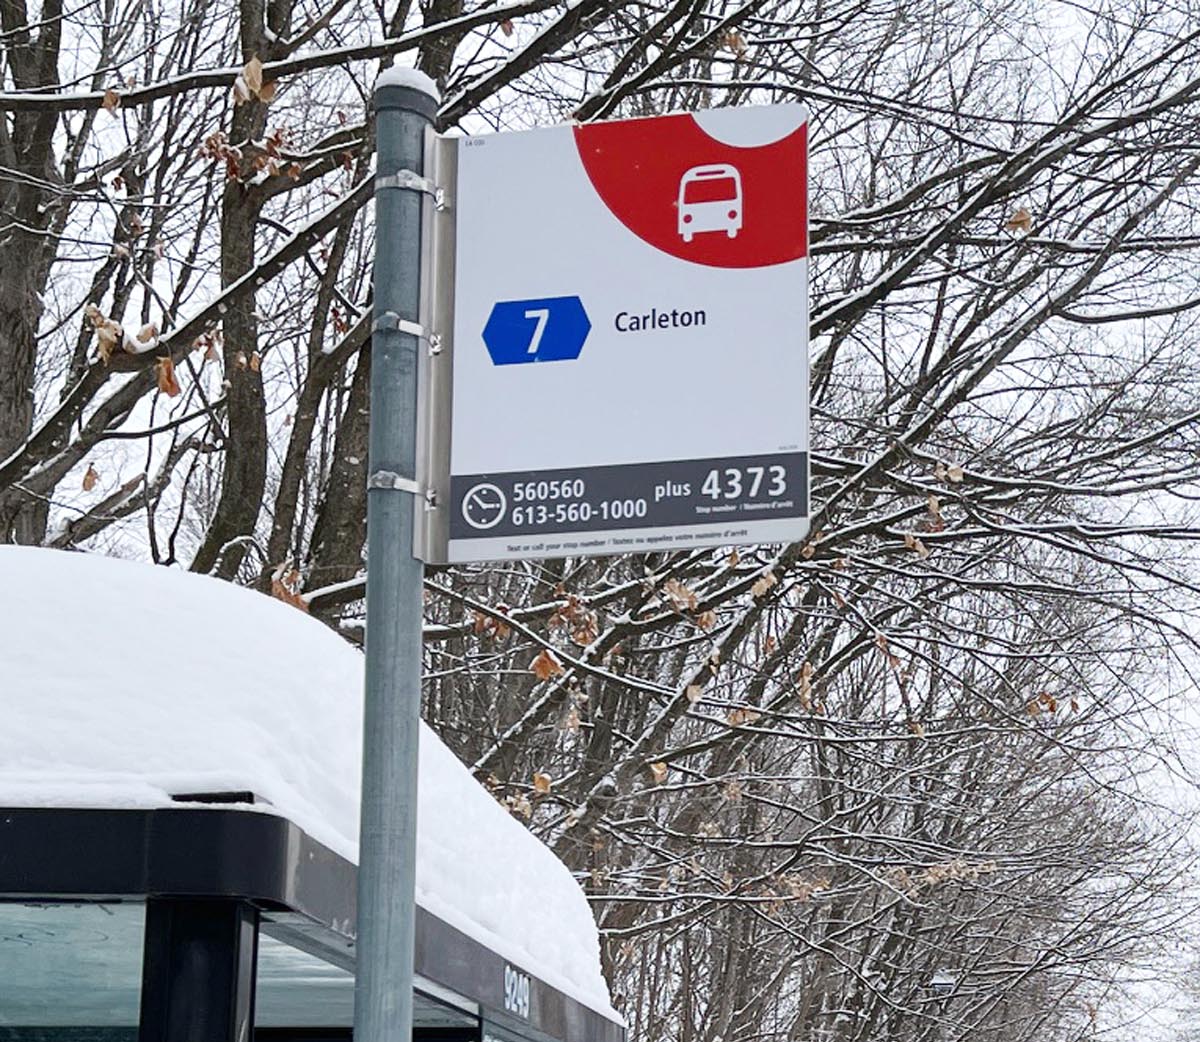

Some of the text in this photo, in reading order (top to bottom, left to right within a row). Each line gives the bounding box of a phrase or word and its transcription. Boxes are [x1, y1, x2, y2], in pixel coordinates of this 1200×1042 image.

[524, 308, 706, 353] 7 Carleton
[513, 479, 585, 502] 560560
[655, 465, 786, 502] plus 4373
[512, 499, 647, 525] 613-560-1000
